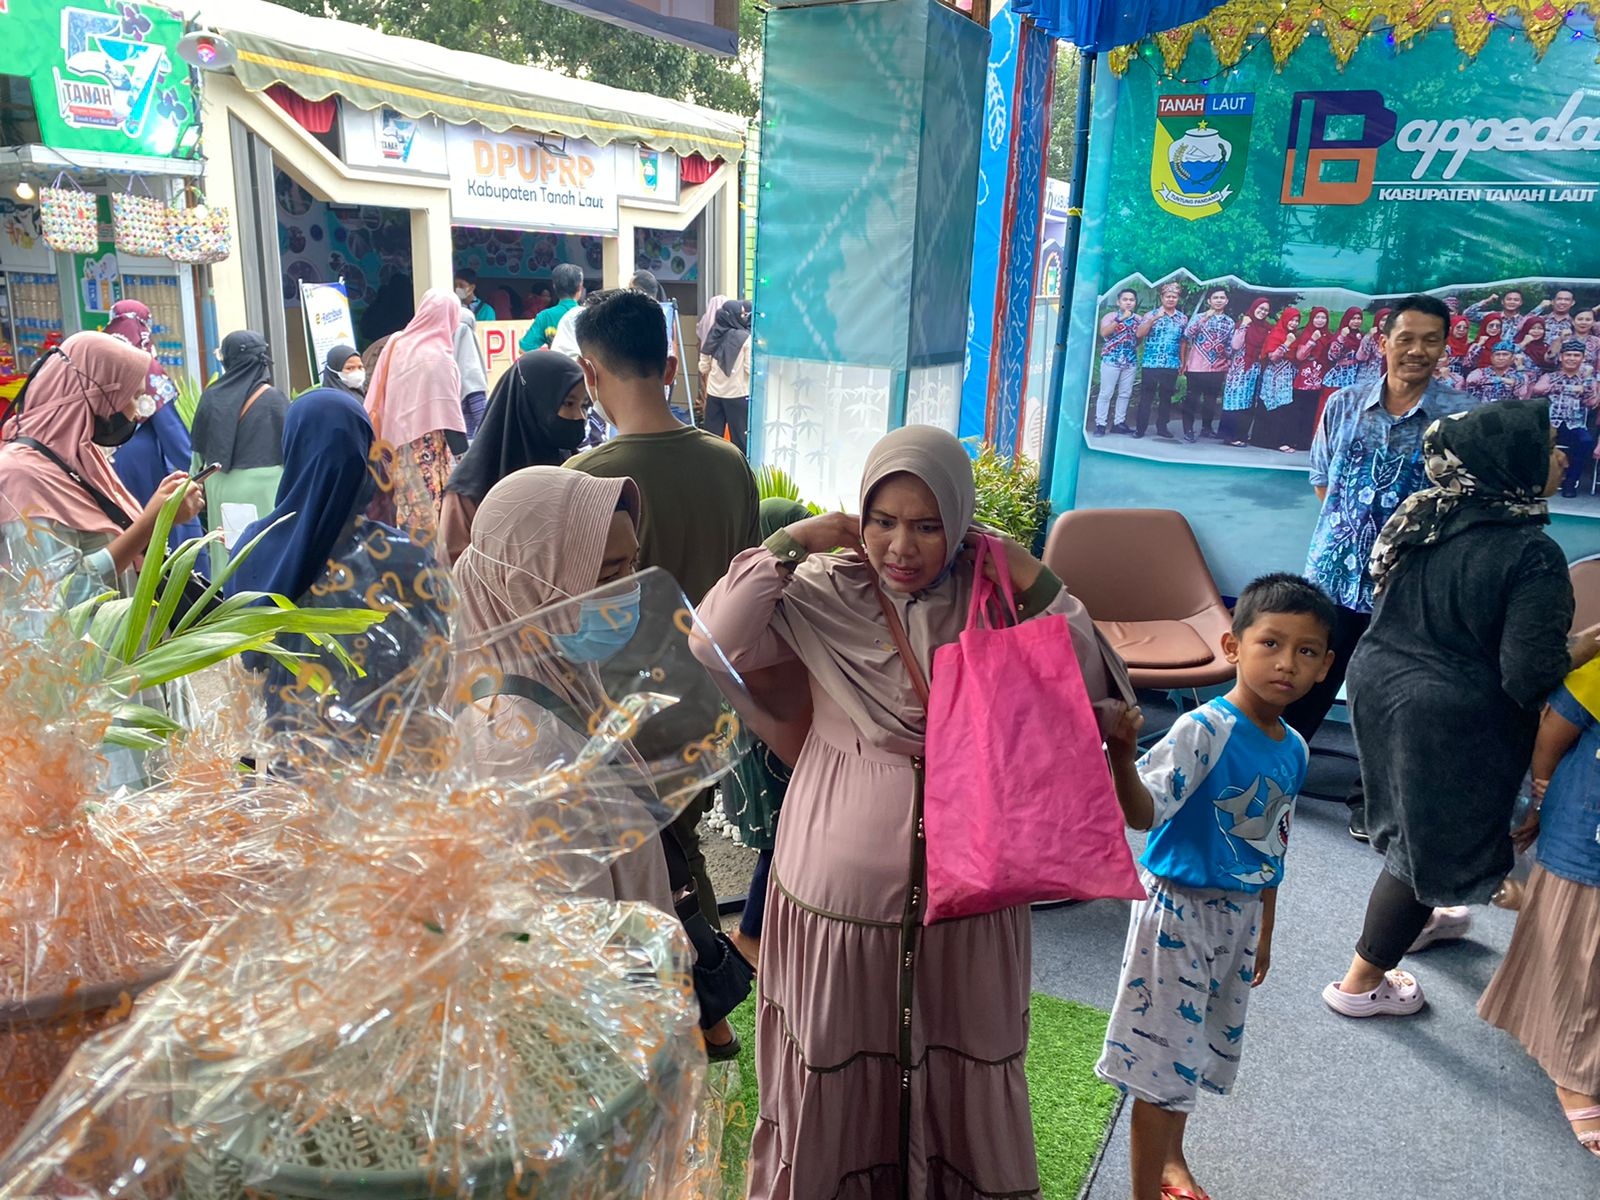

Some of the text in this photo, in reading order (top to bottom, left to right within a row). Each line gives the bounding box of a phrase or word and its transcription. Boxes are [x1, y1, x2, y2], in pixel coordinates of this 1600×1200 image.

[63, 82, 112, 106] TANAH
[1159, 96, 1246, 112] TANAH LAUT
[472, 139, 595, 188] DPUPRP
[467, 179, 604, 208] Kabupaten Tanah Laut
[1378, 188, 1598, 202] KABUPATEN TANAH LAUT
